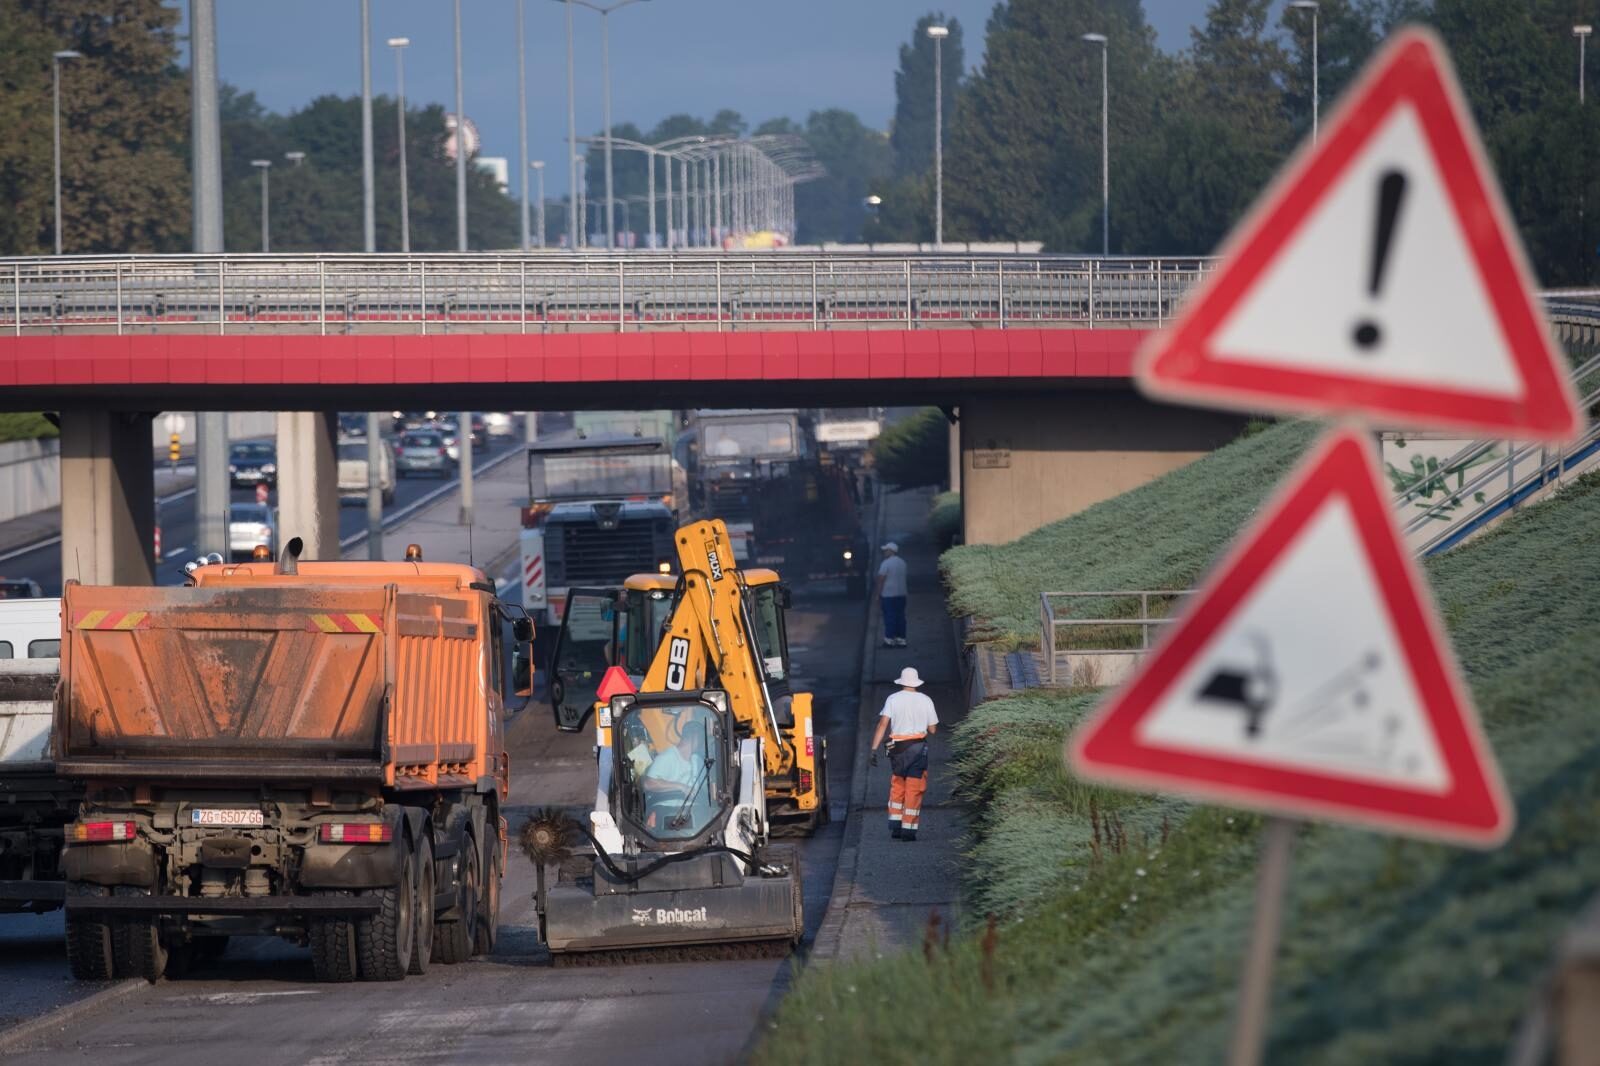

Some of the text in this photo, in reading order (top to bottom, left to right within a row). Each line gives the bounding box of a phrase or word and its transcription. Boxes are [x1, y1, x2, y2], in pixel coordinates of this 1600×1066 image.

[666, 638, 689, 691] CB
[201, 811, 213, 824] ZG
[656, 907, 706, 923] Bobcat
